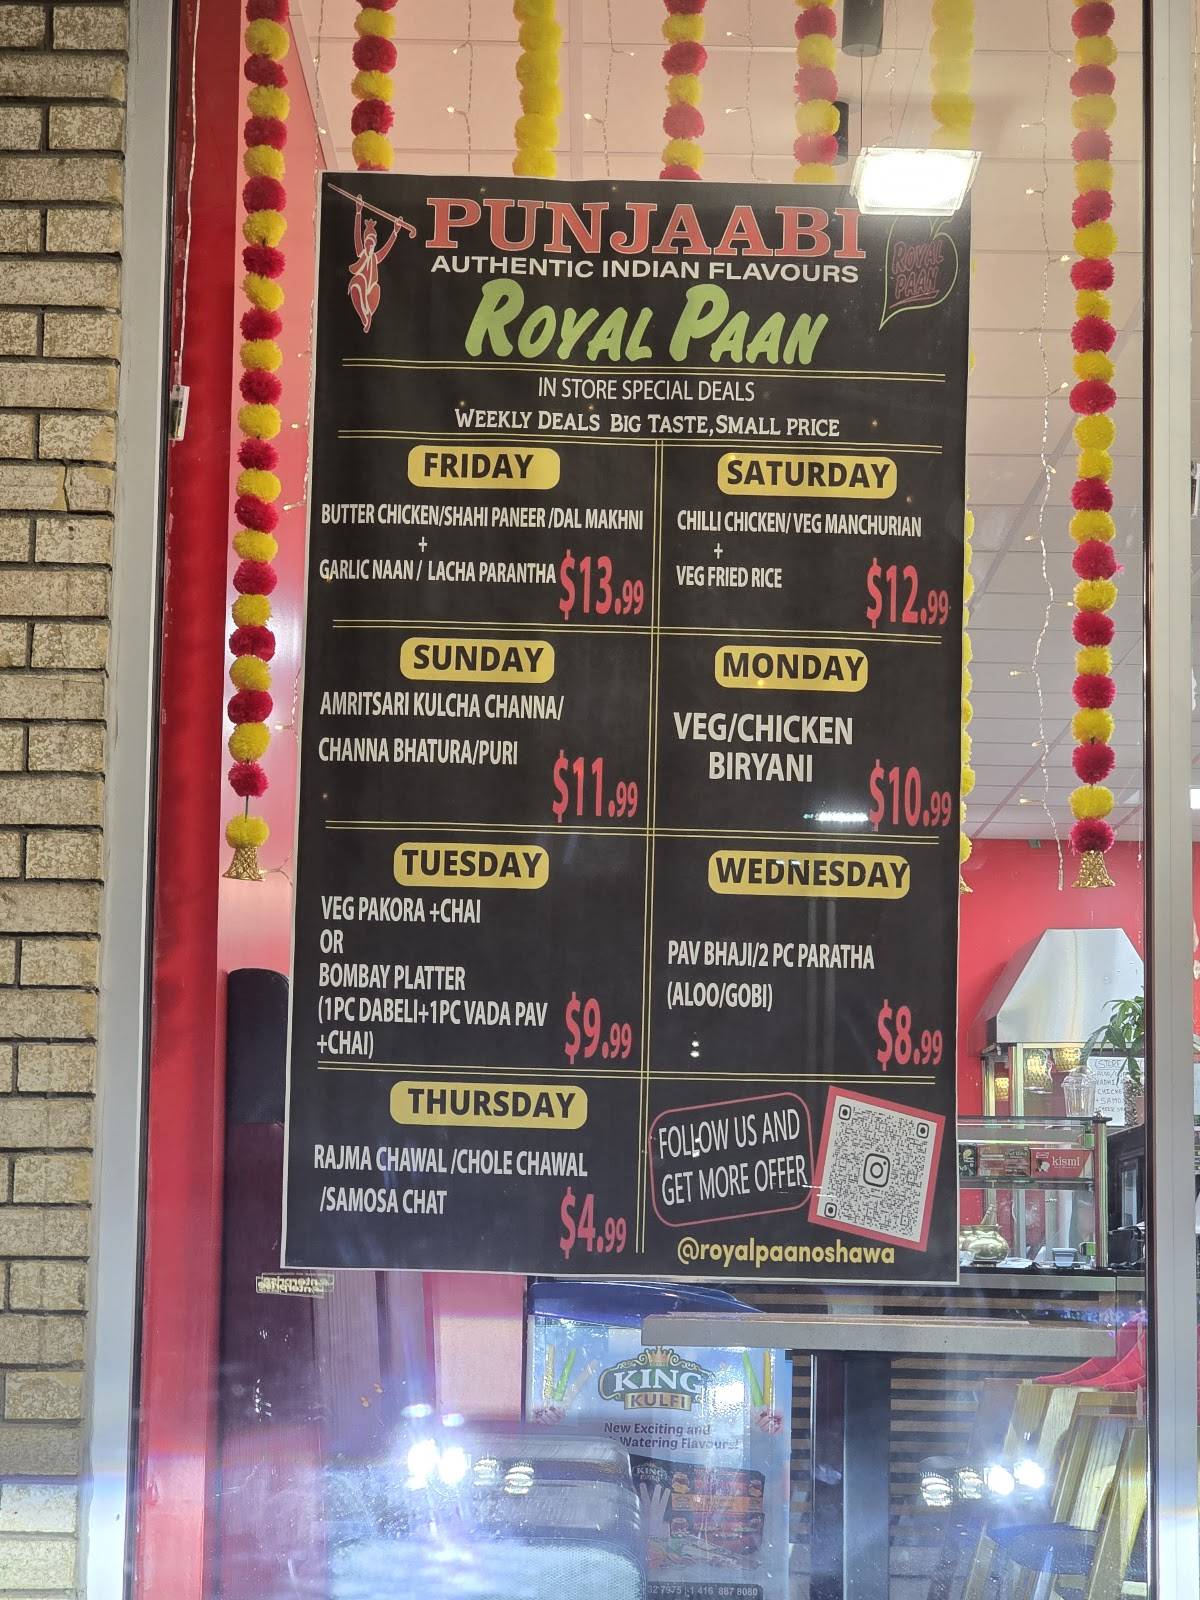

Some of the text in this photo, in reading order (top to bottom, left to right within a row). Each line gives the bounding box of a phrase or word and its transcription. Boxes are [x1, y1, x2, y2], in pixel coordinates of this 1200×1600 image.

[425, 197, 866, 259] PUNJAABI
[431, 255, 859, 283] AUTHENTIC INDIAN FLAVOURS
[892, 240, 945, 275] ROYAL
[895, 266, 940, 300] PAAN
[464, 278, 829, 365] ROYAL PAAN
[538, 377, 755, 402] IN STORE SPECIAL DEALS
[455, 408, 532, 430] WEEKLY
[538, 410, 600, 431] DEALS
[610, 413, 641, 433] BIG
[786, 418, 840, 437] PRICE
[423, 452, 534, 479] FRIDAY
[726, 459, 890, 489] SATURDAY
[321, 503, 374, 525] BUTTER
[377, 504, 488, 527] CHICKEN/SHAHI
[492, 507, 546, 528] PANEER
[585, 508, 643, 530] MAKHNI
[677, 509, 721, 531] CHILLI
[825, 514, 922, 537] MANCHURIAN
[418, 536, 428, 552] +
[713, 543, 723, 559] +
[319, 558, 369, 580] GARLIC
[372, 559, 413, 581] NAAN
[428, 560, 476, 582] LACHA
[479, 561, 557, 584] PARANTHA
[559, 549, 644, 620] $13.99
[676, 565, 782, 588] VEG FRIED RICE
[866, 557, 949, 629] $12.99
[413, 644, 544, 673] SUNDAY
[722, 652, 864, 682] MONDAY
[319, 691, 565, 721] AMRITSARI KULCHA CHANNA/
[673, 711, 853, 745] VEG/CHICKEN
[318, 737, 518, 765] CHANNA BHATURA/PURI
[708, 751, 813, 783] BIRYANI
[552, 749, 639, 824] $11.99
[869, 758, 951, 832] $10.99
[401, 849, 543, 878] TUESDAY
[715, 857, 909, 889] WEDNESDAY
[321, 895, 481, 923] VEG PAKORA +CHAI
[320, 929, 343, 954] OR
[667, 940, 875, 970] PAV BHAJI/2 PC PARATHA
[319, 962, 466, 991] BOMBAY PLATTER
[317, 996, 355, 1024] (1PC
[464, 1001, 511, 1025] VADA
[515, 1002, 548, 1027] PAV
[667, 981, 773, 1012] (ALOO/GOBI)
[564, 991, 632, 1064] $9.99
[876, 999, 943, 1072] $8.99
[316, 1029, 374, 1059] +CHAI)
[408, 1088, 576, 1118] THURSDAY
[658, 1108, 800, 1160] FOLLOW US AND
[314, 1144, 588, 1177] RAJMA CHAWAL /CHOLE CHAWAL
[661, 1154, 808, 1206] GET MORE OFFER
[320, 1186, 447, 1215] /SAMOSA CHAT
[559, 1186, 627, 1259] $4.99
[677, 1236, 895, 1268] @royalpaanoshawa
[613, 1368, 702, 1394] KING
[630, 1393, 685, 1409] KULFI
[604, 1422, 711, 1437] New Exciting and
[619, 1436, 678, 1450] Watering
